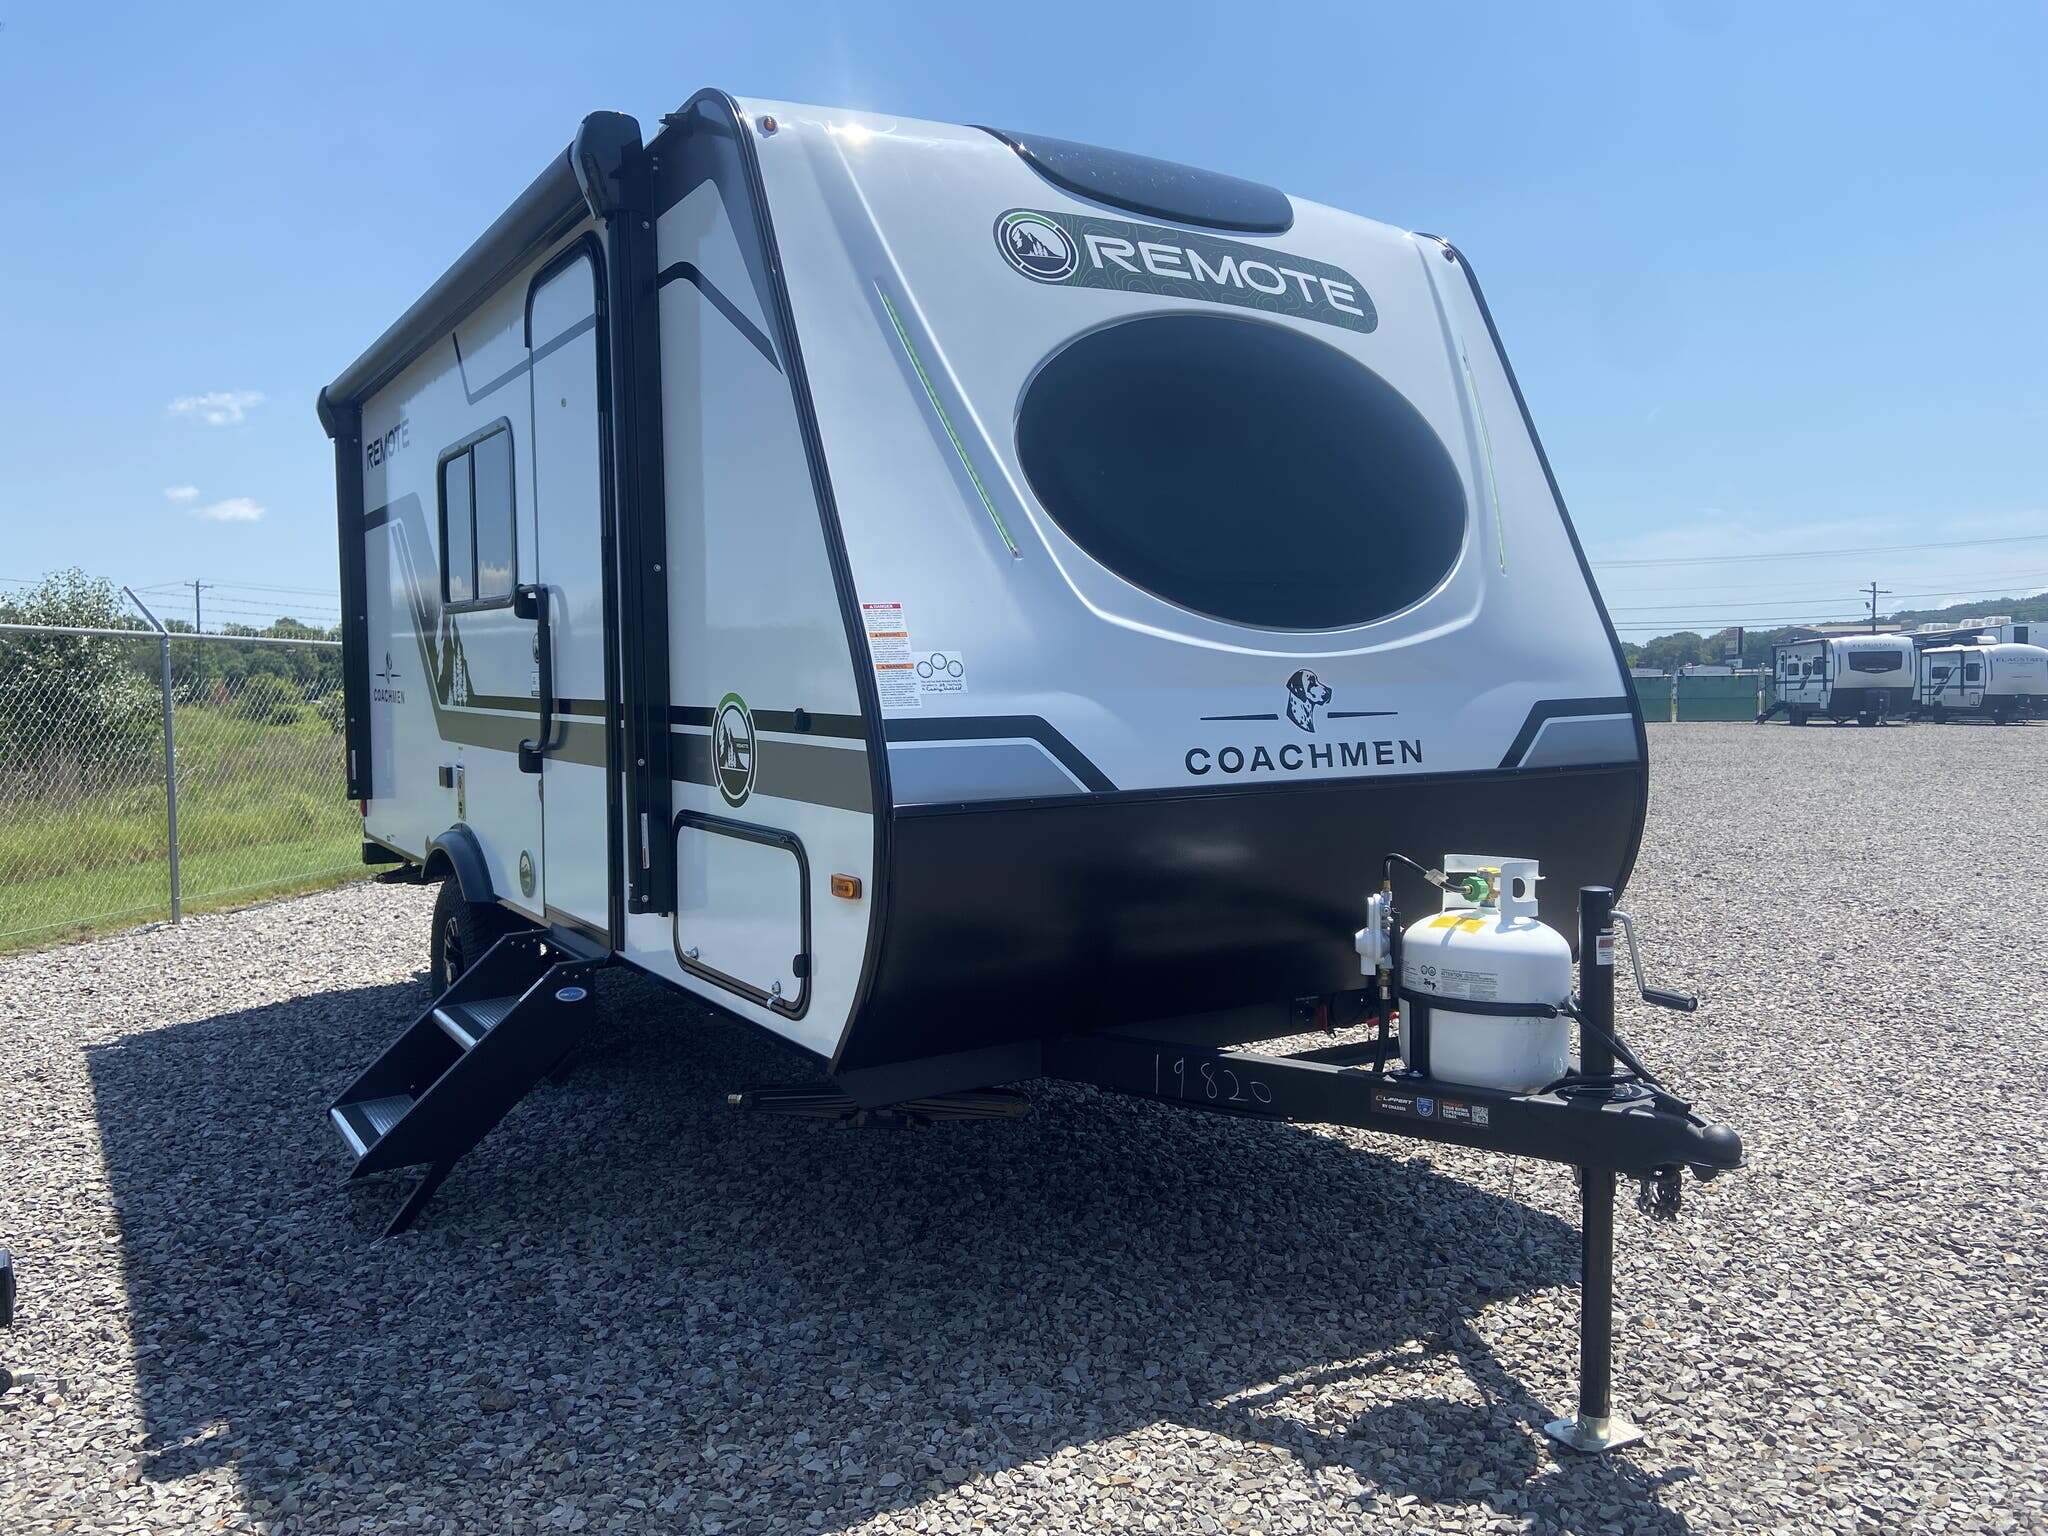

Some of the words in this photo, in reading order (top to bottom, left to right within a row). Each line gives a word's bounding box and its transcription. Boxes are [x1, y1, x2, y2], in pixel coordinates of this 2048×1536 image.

[1083, 233, 1364, 317] REMOTE
[367, 418, 410, 471] REMOTE
[374, 688, 405, 703] COACHMEN
[1184, 739, 1423, 776] COACHMEN
[1155, 1053, 1272, 1104] 19820
